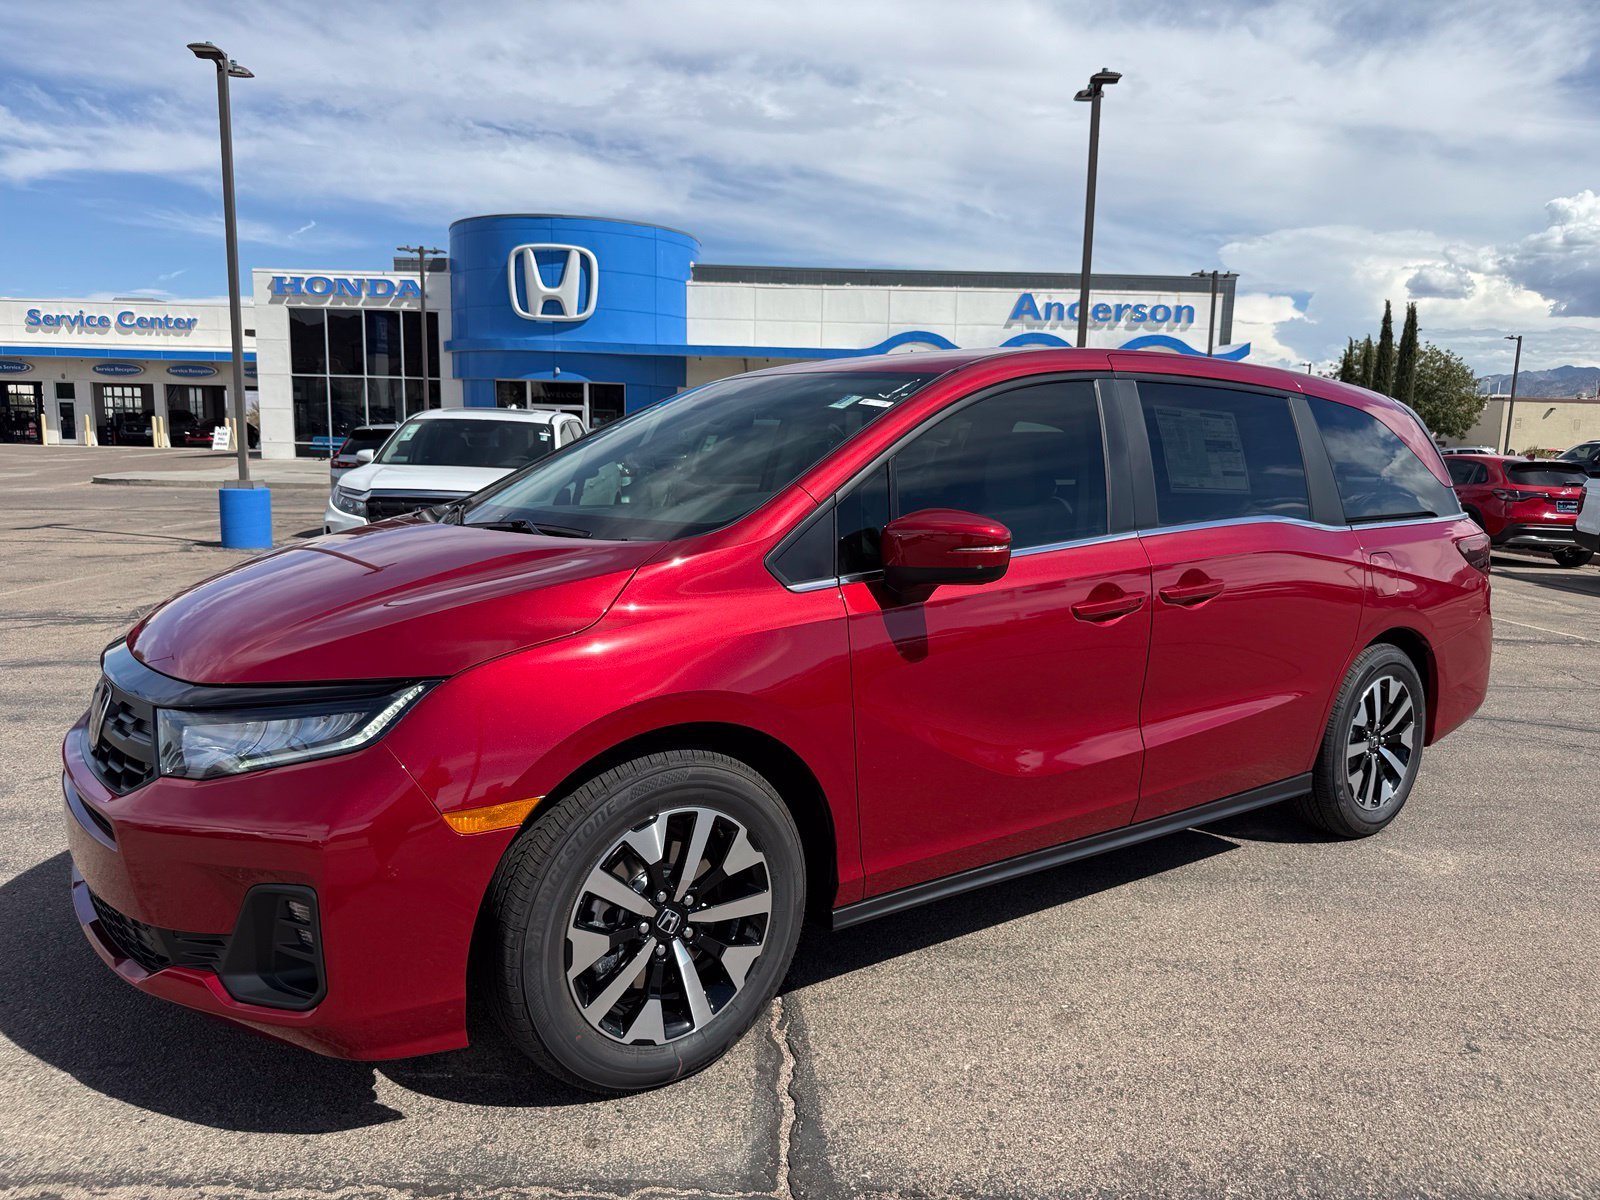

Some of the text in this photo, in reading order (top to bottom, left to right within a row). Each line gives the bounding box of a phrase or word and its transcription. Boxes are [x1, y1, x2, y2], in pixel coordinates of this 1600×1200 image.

[271, 276, 421, 298] HONDA
[27, 309, 198, 330] Service Center
